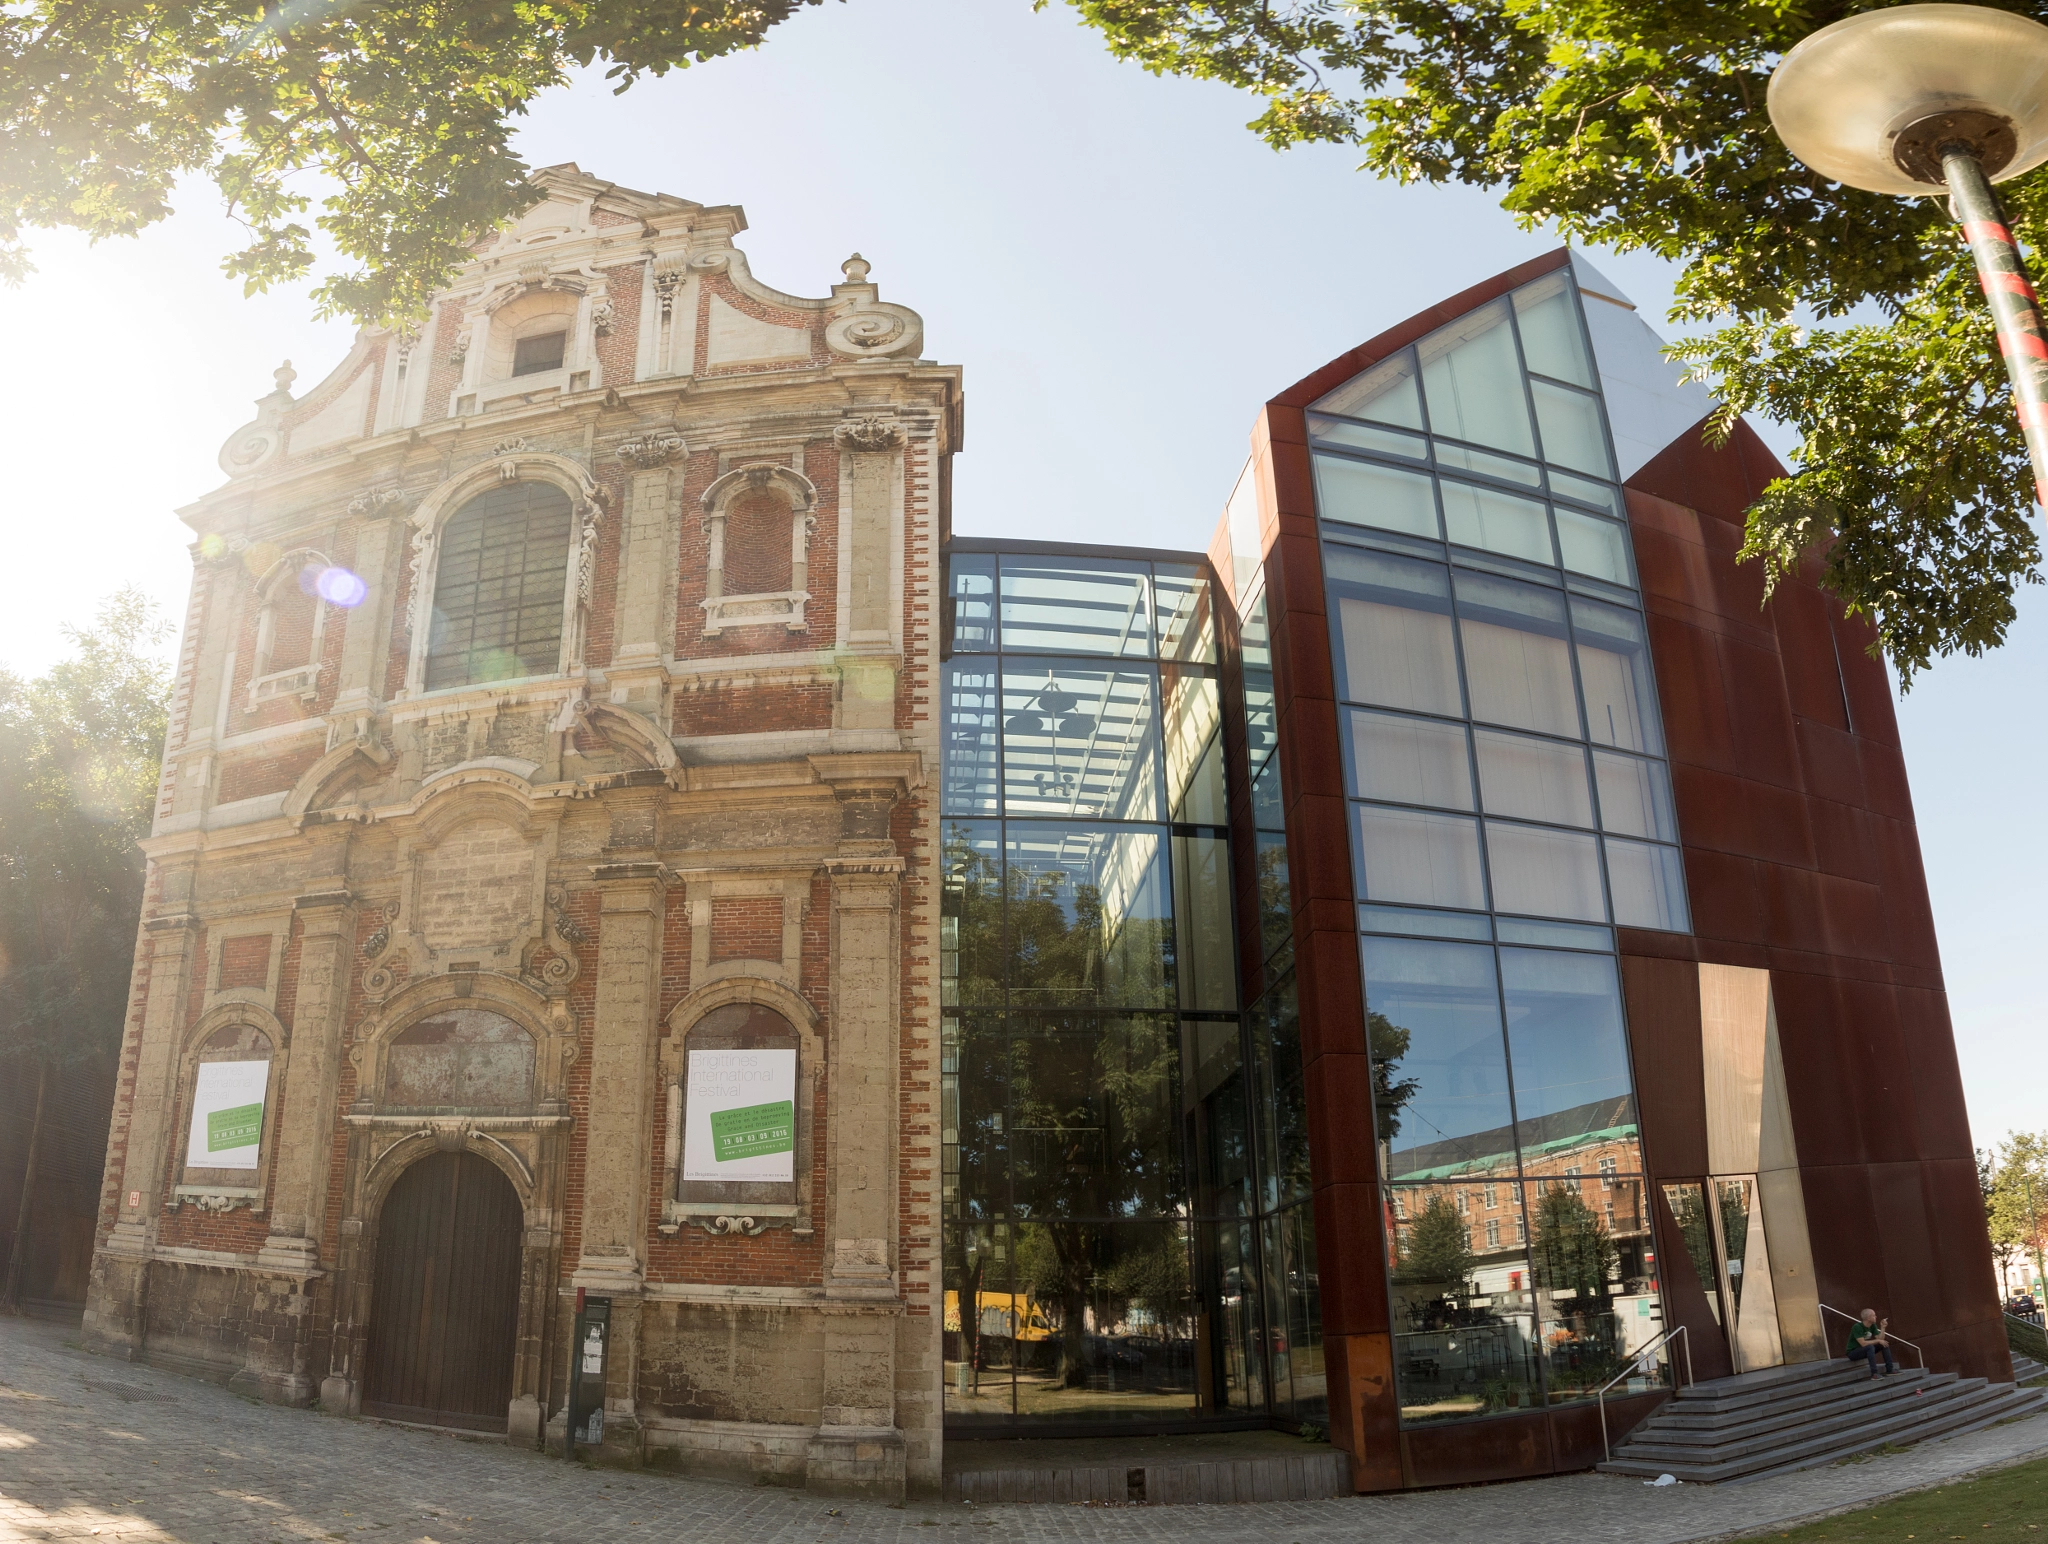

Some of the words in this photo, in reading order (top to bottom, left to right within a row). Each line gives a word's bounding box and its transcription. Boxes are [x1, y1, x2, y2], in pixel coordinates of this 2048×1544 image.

[691, 1053, 758, 1070] Brigittines
[690, 1068, 774, 1082] International
[690, 1083, 741, 1097] Festival
[772, 1129, 787, 1138] 2016
[131, 1194, 138, 1204] H
